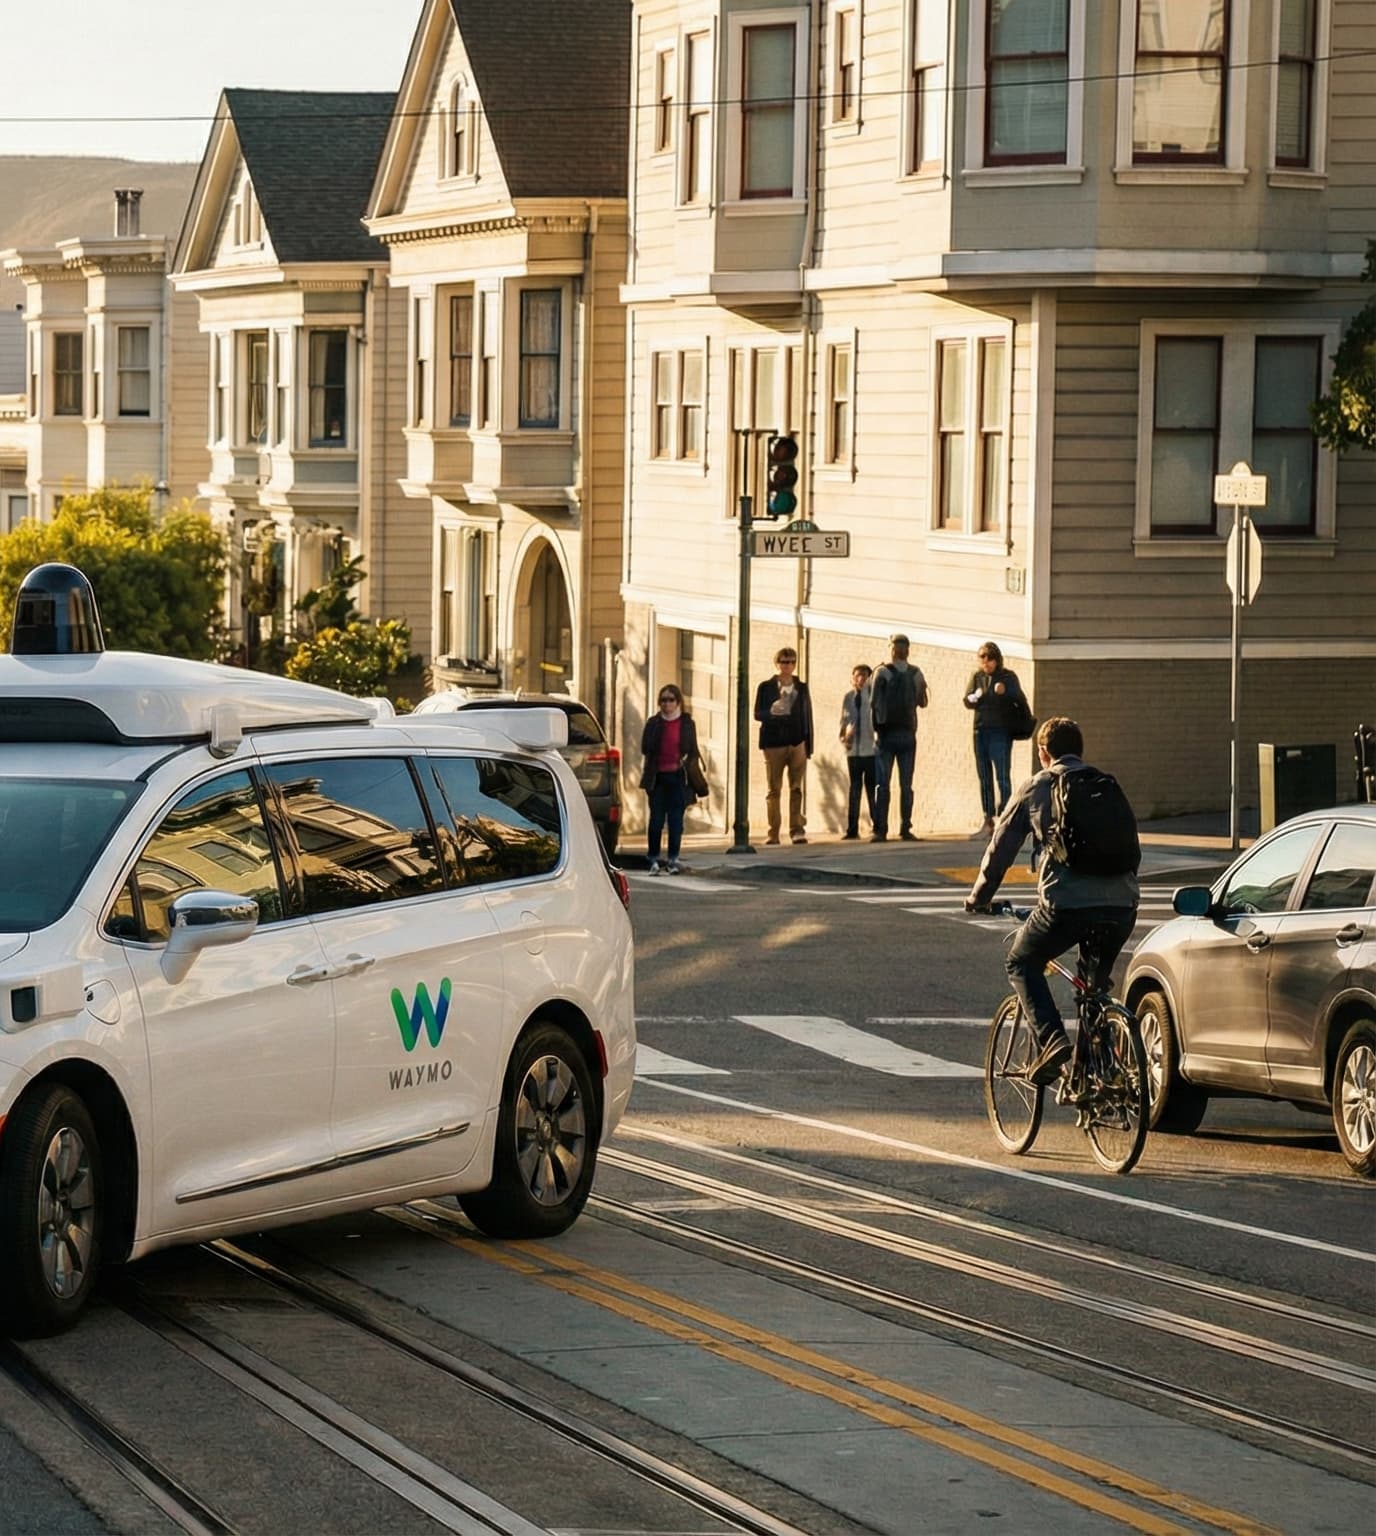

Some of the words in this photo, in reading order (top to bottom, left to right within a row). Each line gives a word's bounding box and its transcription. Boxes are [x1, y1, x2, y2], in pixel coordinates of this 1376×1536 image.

[824, 537, 842, 549] ST
[390, 976, 452, 1052] W
[389, 1060, 452, 1090] WAYMO
